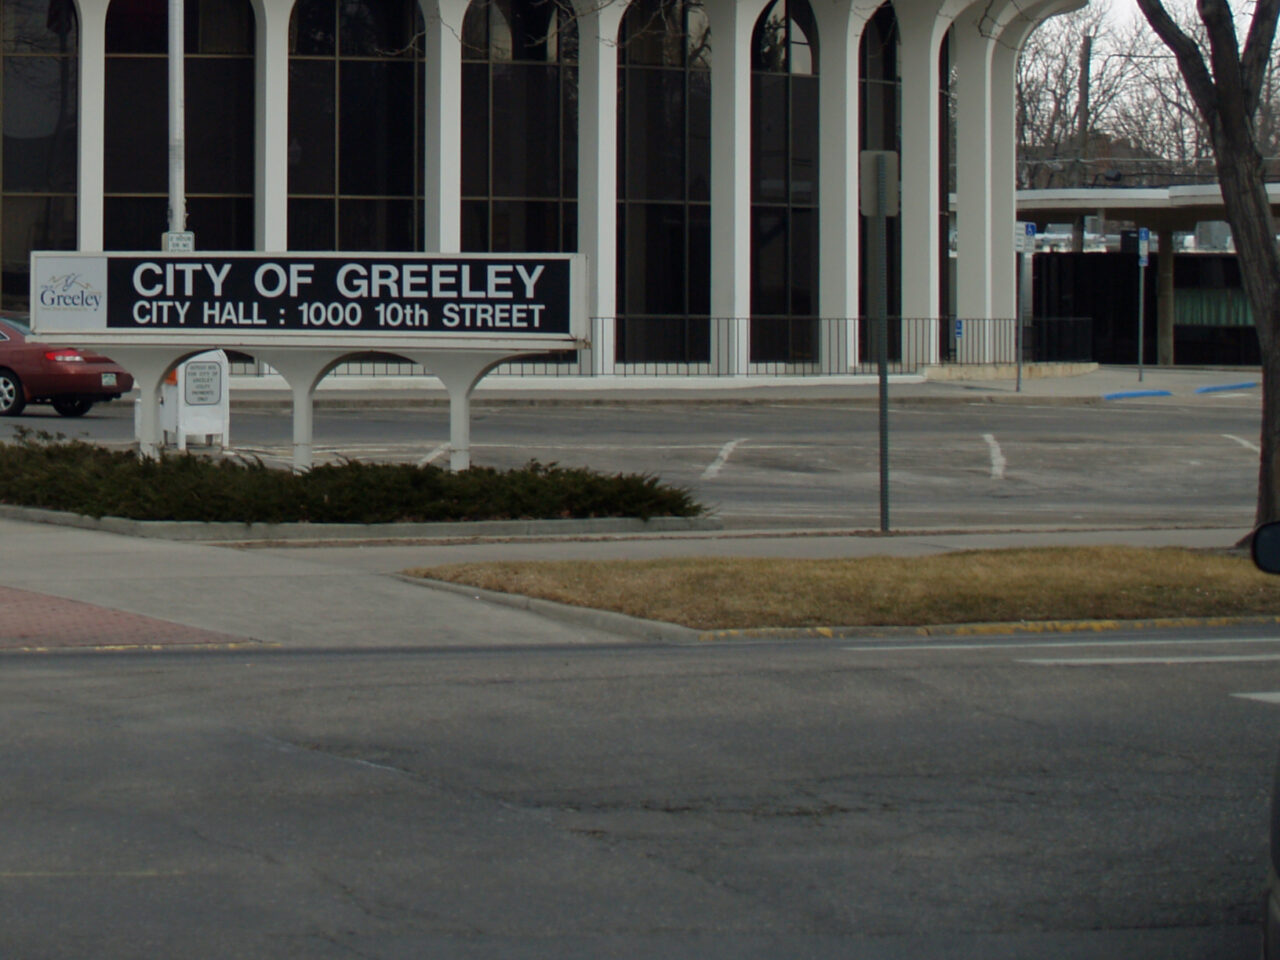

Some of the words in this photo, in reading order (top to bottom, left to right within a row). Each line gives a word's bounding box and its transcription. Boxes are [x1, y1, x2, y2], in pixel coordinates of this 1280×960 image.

[132, 262, 232, 297] CITY
[254, 262, 315, 298] OF
[336, 263, 545, 299] GREELEY
[40, 289, 101, 312] Greeley
[132, 300, 191, 324] CITY
[203, 301, 267, 325] HALL
[298, 301, 362, 326] 1000
[374, 302, 429, 327] 10th
[442, 303, 546, 328] STREET
